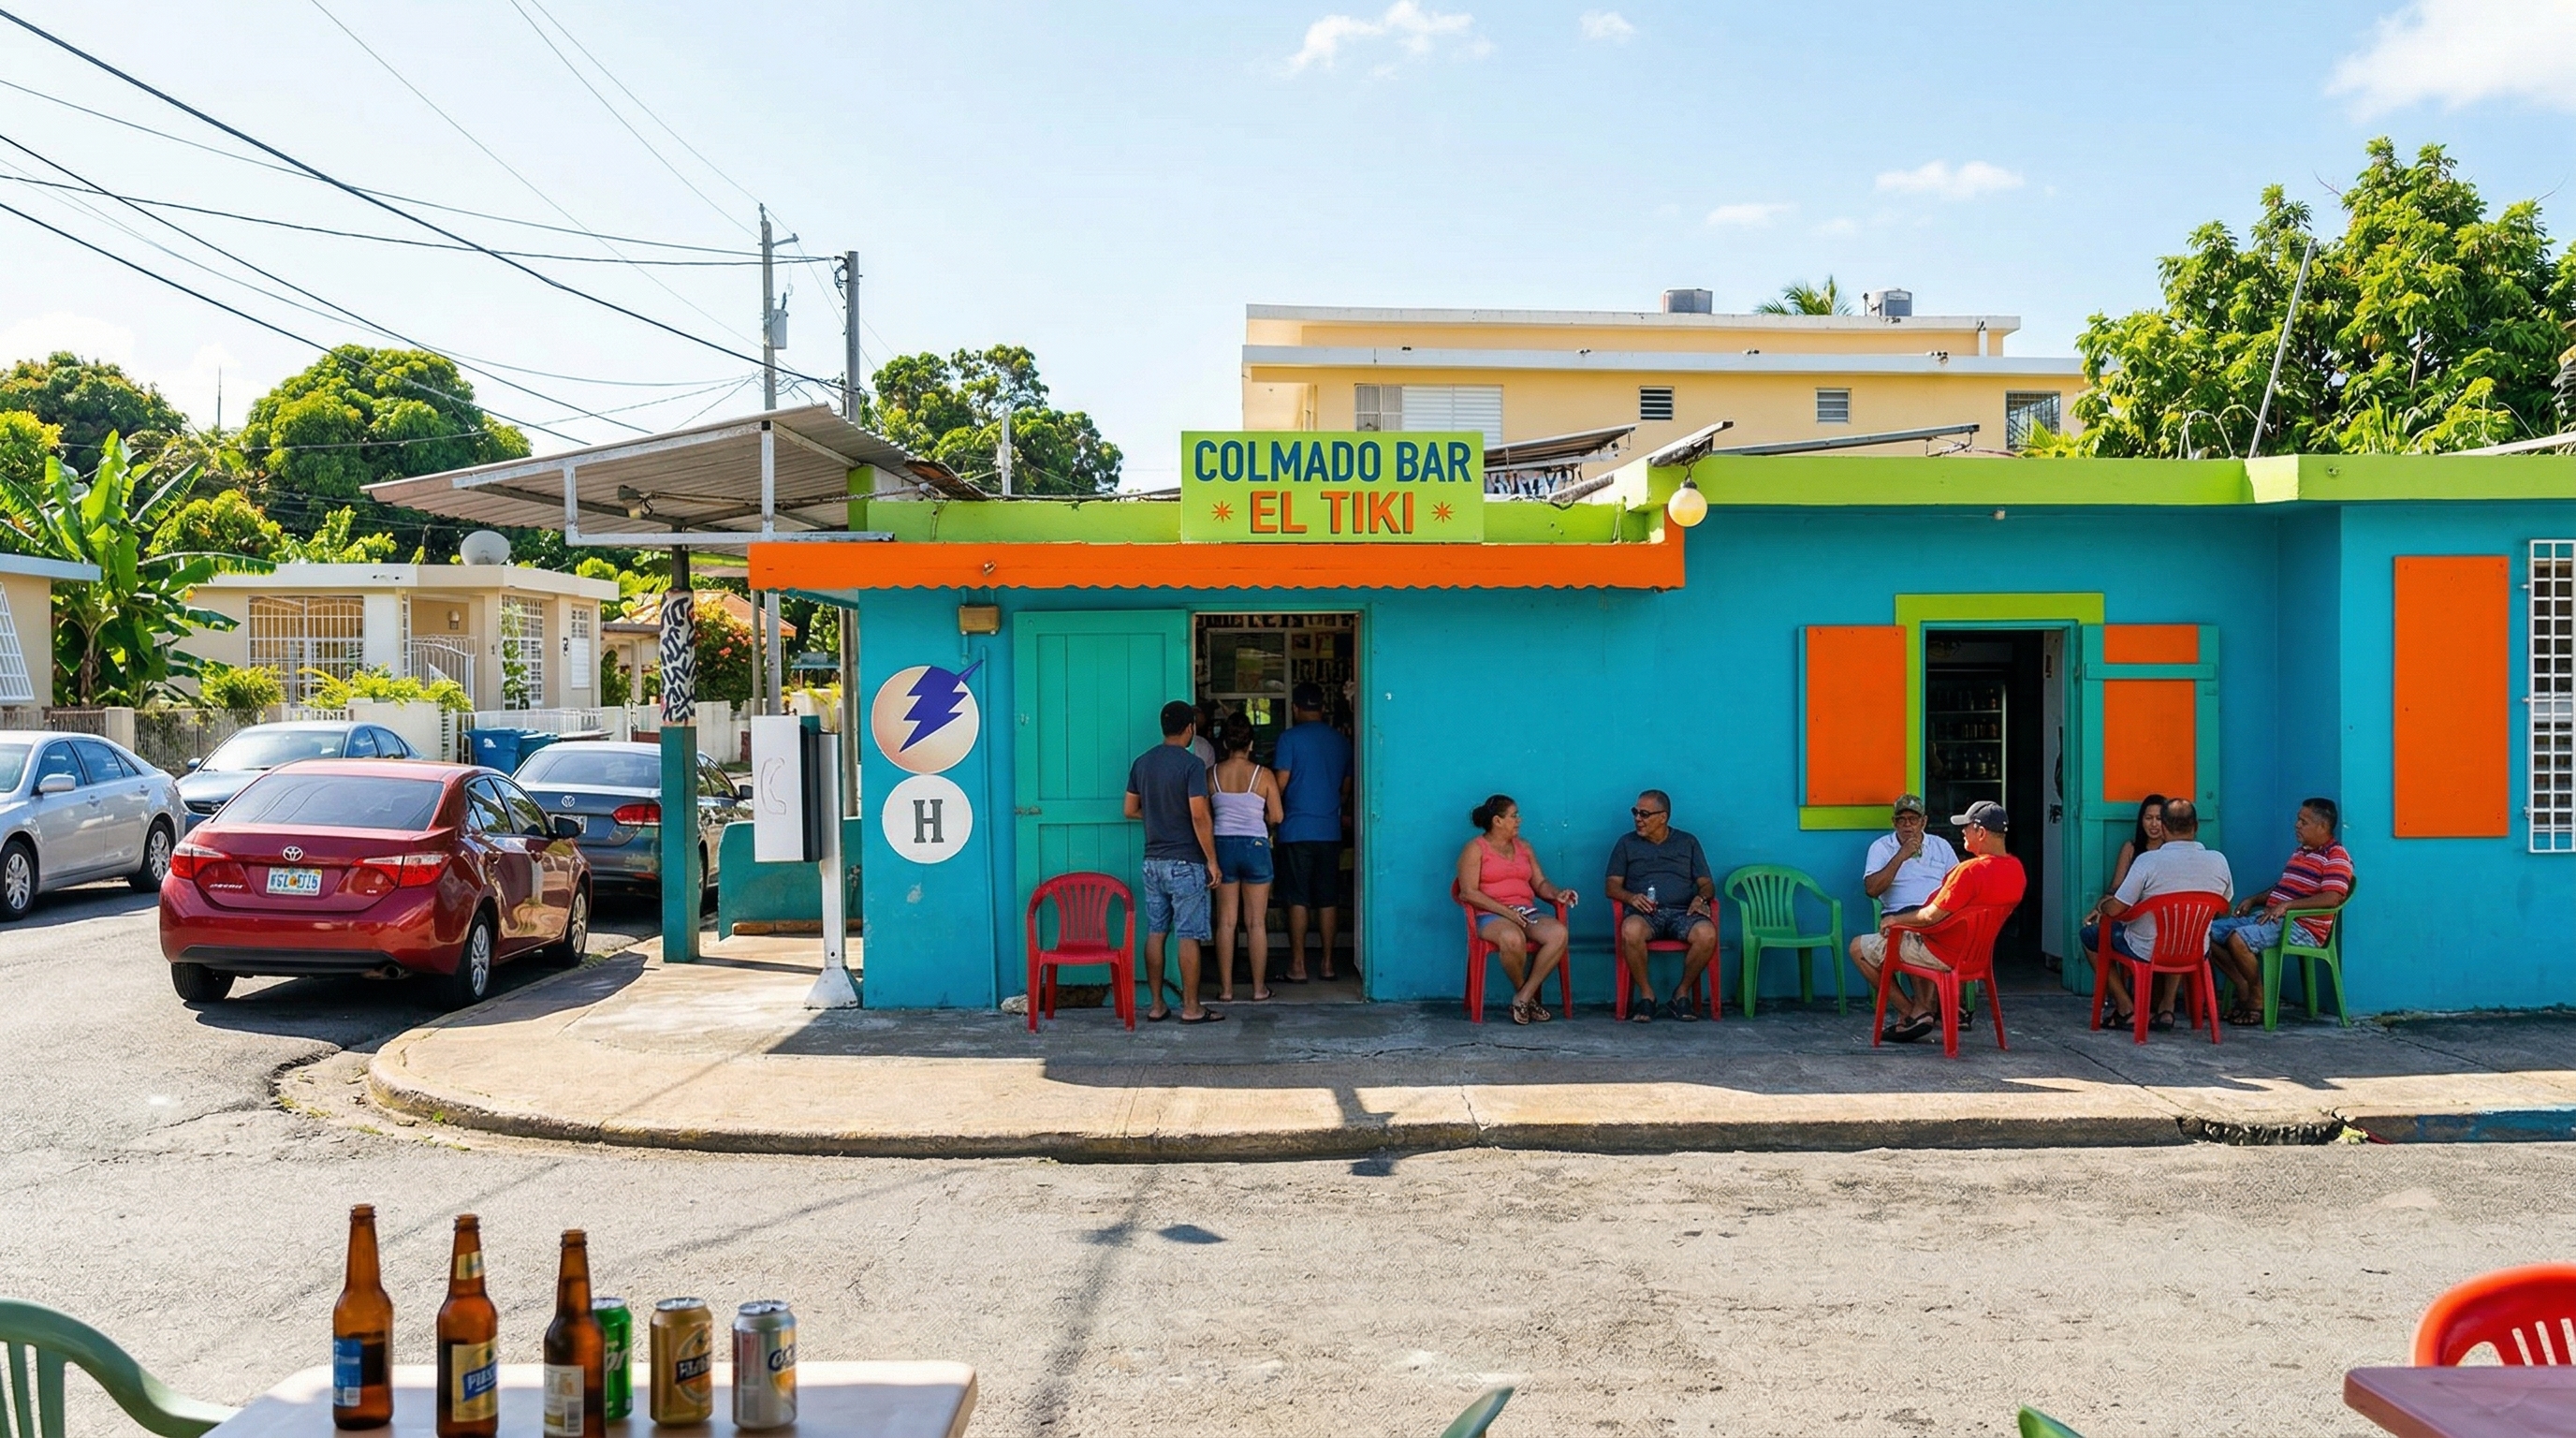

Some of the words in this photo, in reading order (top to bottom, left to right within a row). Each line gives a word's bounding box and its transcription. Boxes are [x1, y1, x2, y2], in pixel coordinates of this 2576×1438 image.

[1194, 440, 1382, 482] COLMADO
[1396, 441, 1472, 482] BAR
[1250, 491, 1308, 535] EL
[1320, 491, 1414, 535] TIKI
[913, 799, 944, 844] H
